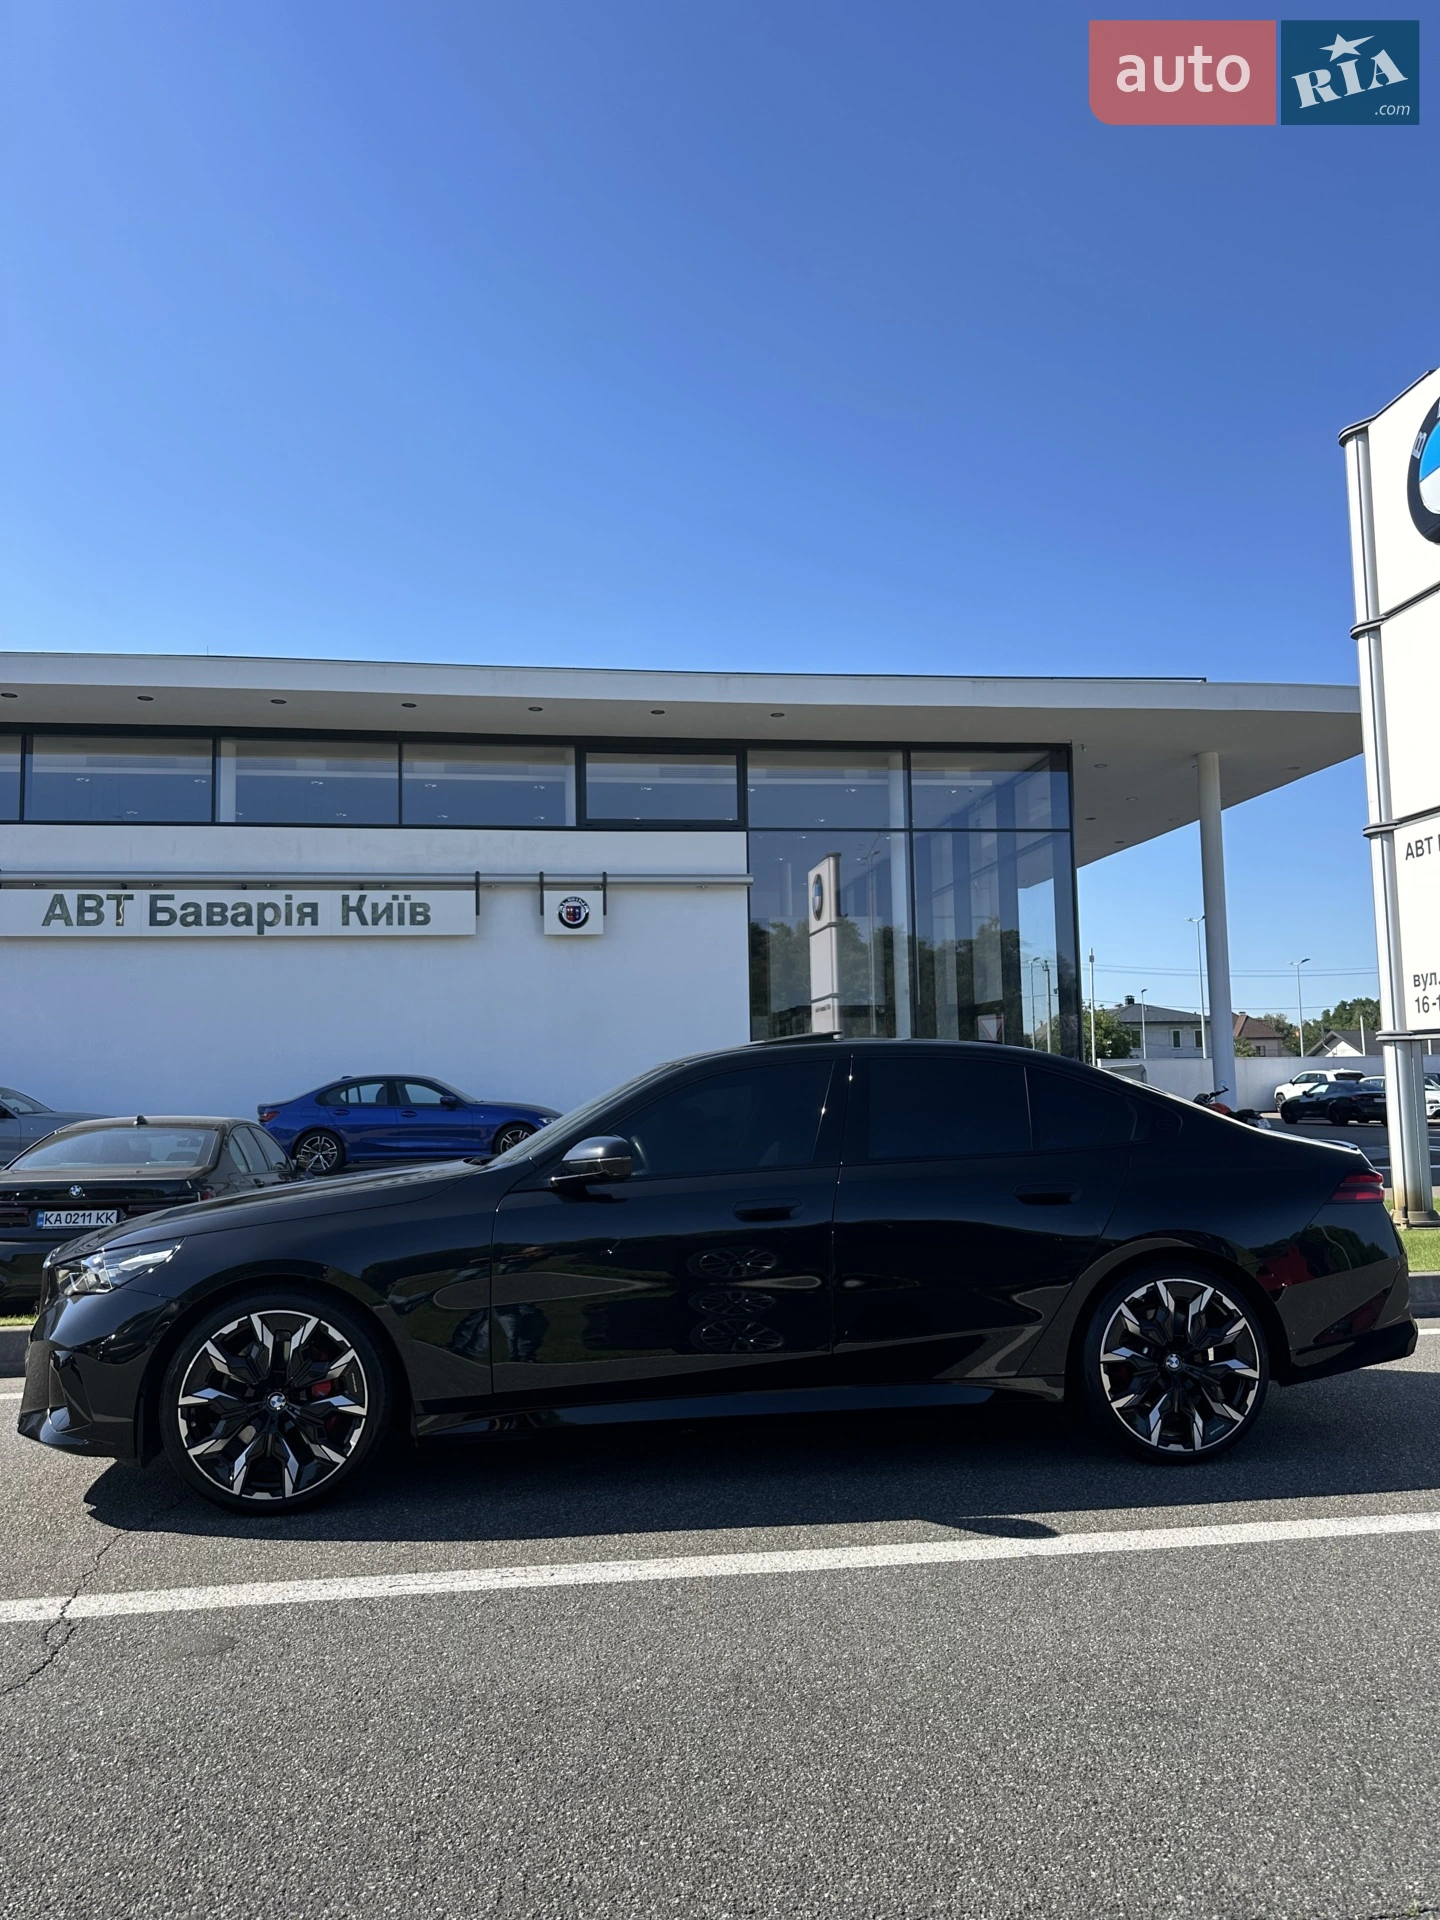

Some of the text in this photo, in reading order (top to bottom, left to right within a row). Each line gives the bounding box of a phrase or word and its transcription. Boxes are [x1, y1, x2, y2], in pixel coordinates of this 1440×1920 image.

[41, 893, 431, 935] АВТ Баварія Київ
[44, 1213, 62, 1225] KA
[65, 1212, 92, 1225] 0211
[96, 1212, 115, 1224] KK
